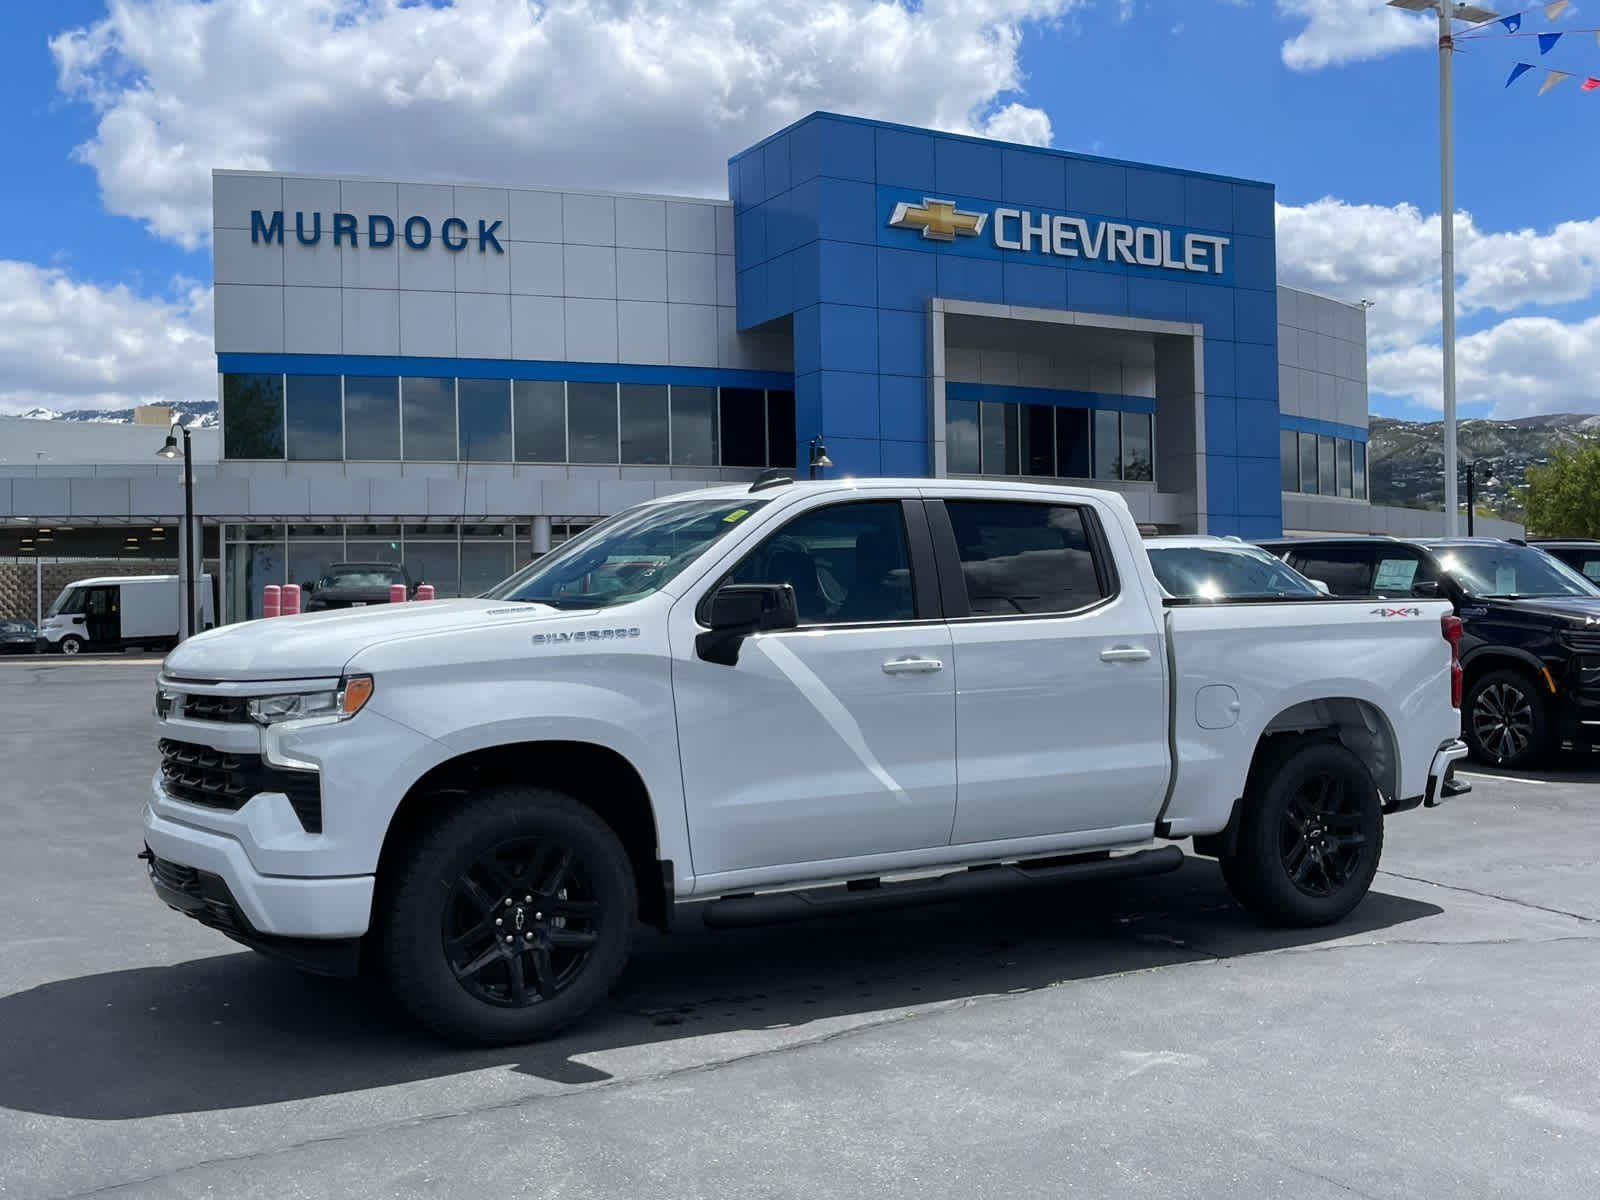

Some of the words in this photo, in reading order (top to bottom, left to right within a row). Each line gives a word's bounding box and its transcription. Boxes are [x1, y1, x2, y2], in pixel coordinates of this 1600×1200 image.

[250, 210, 505, 254] MURDOCK
[994, 207, 1230, 274] CHEVROLET
[532, 627, 641, 644] SILVERADO
